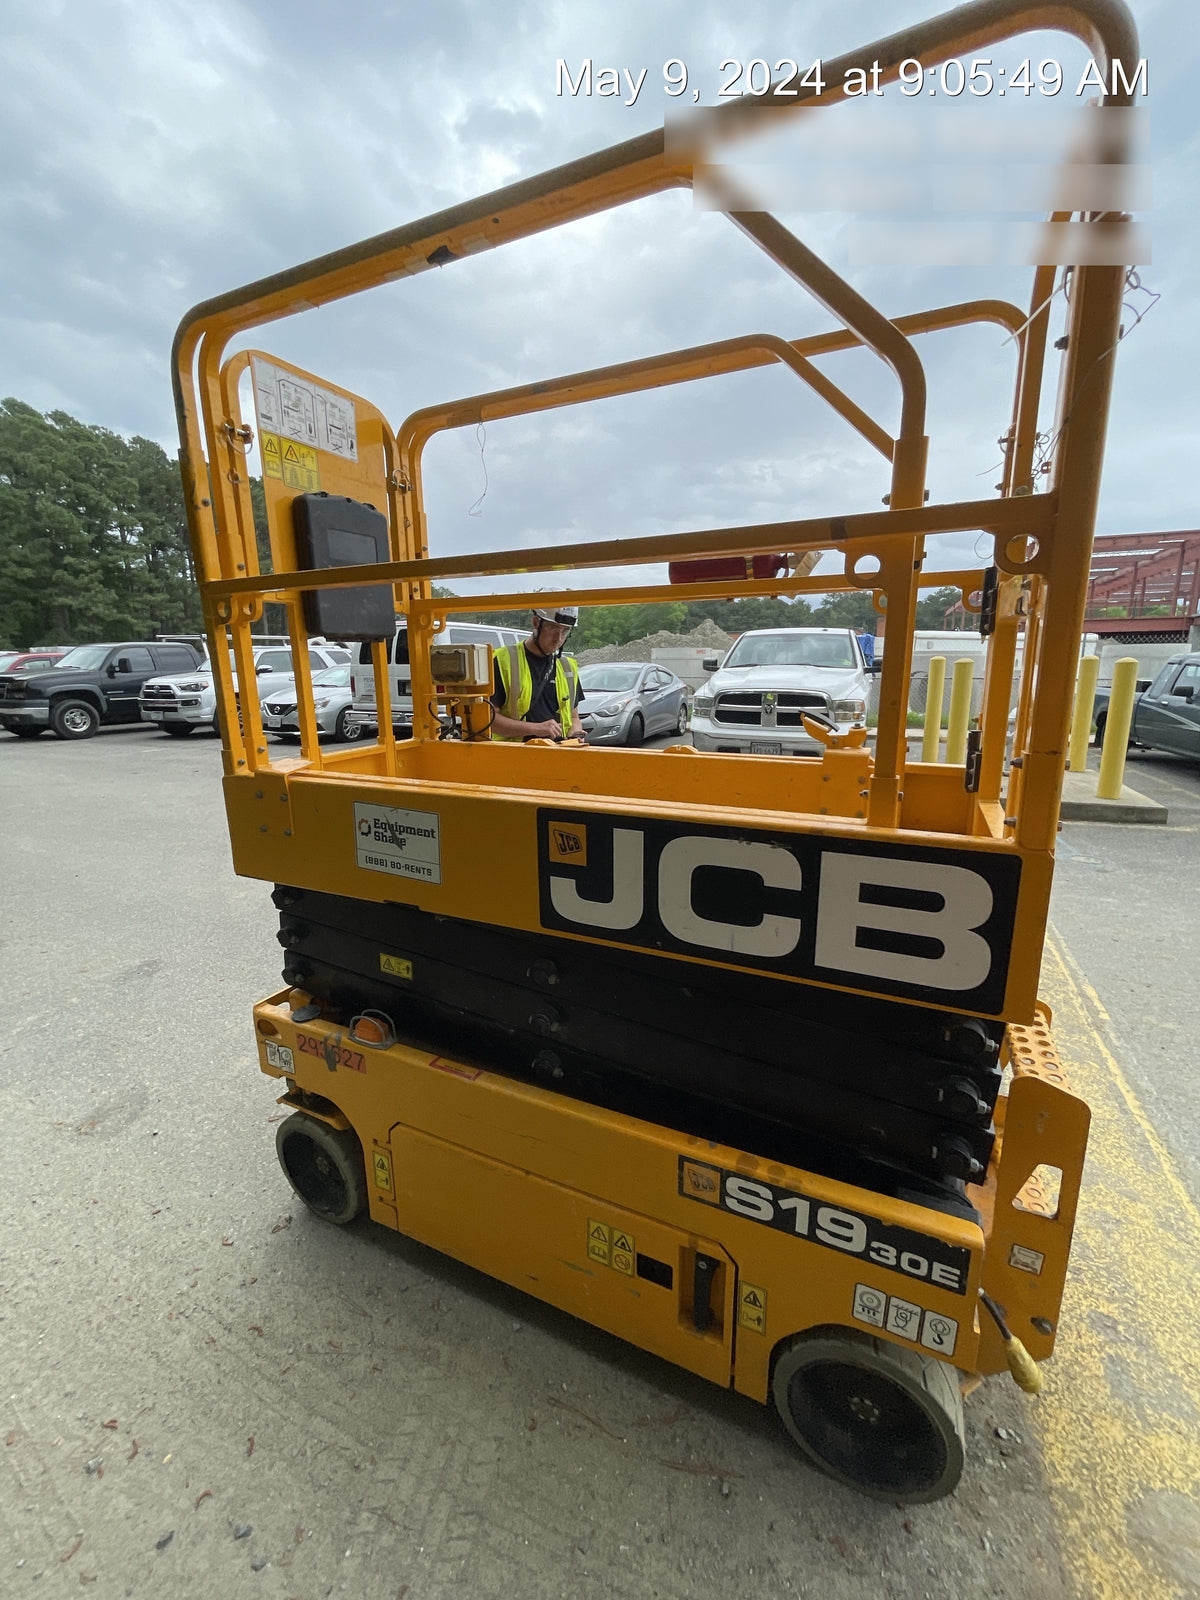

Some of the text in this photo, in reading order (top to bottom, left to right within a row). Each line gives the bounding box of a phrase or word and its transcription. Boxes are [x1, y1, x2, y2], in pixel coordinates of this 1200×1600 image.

[373, 818, 437, 839] Equipment
[374, 831, 407, 846] Shae
[559, 833, 580, 852] JCB
[365, 855, 432, 876] (888) 80-RENTS
[550, 827, 994, 991] JCB
